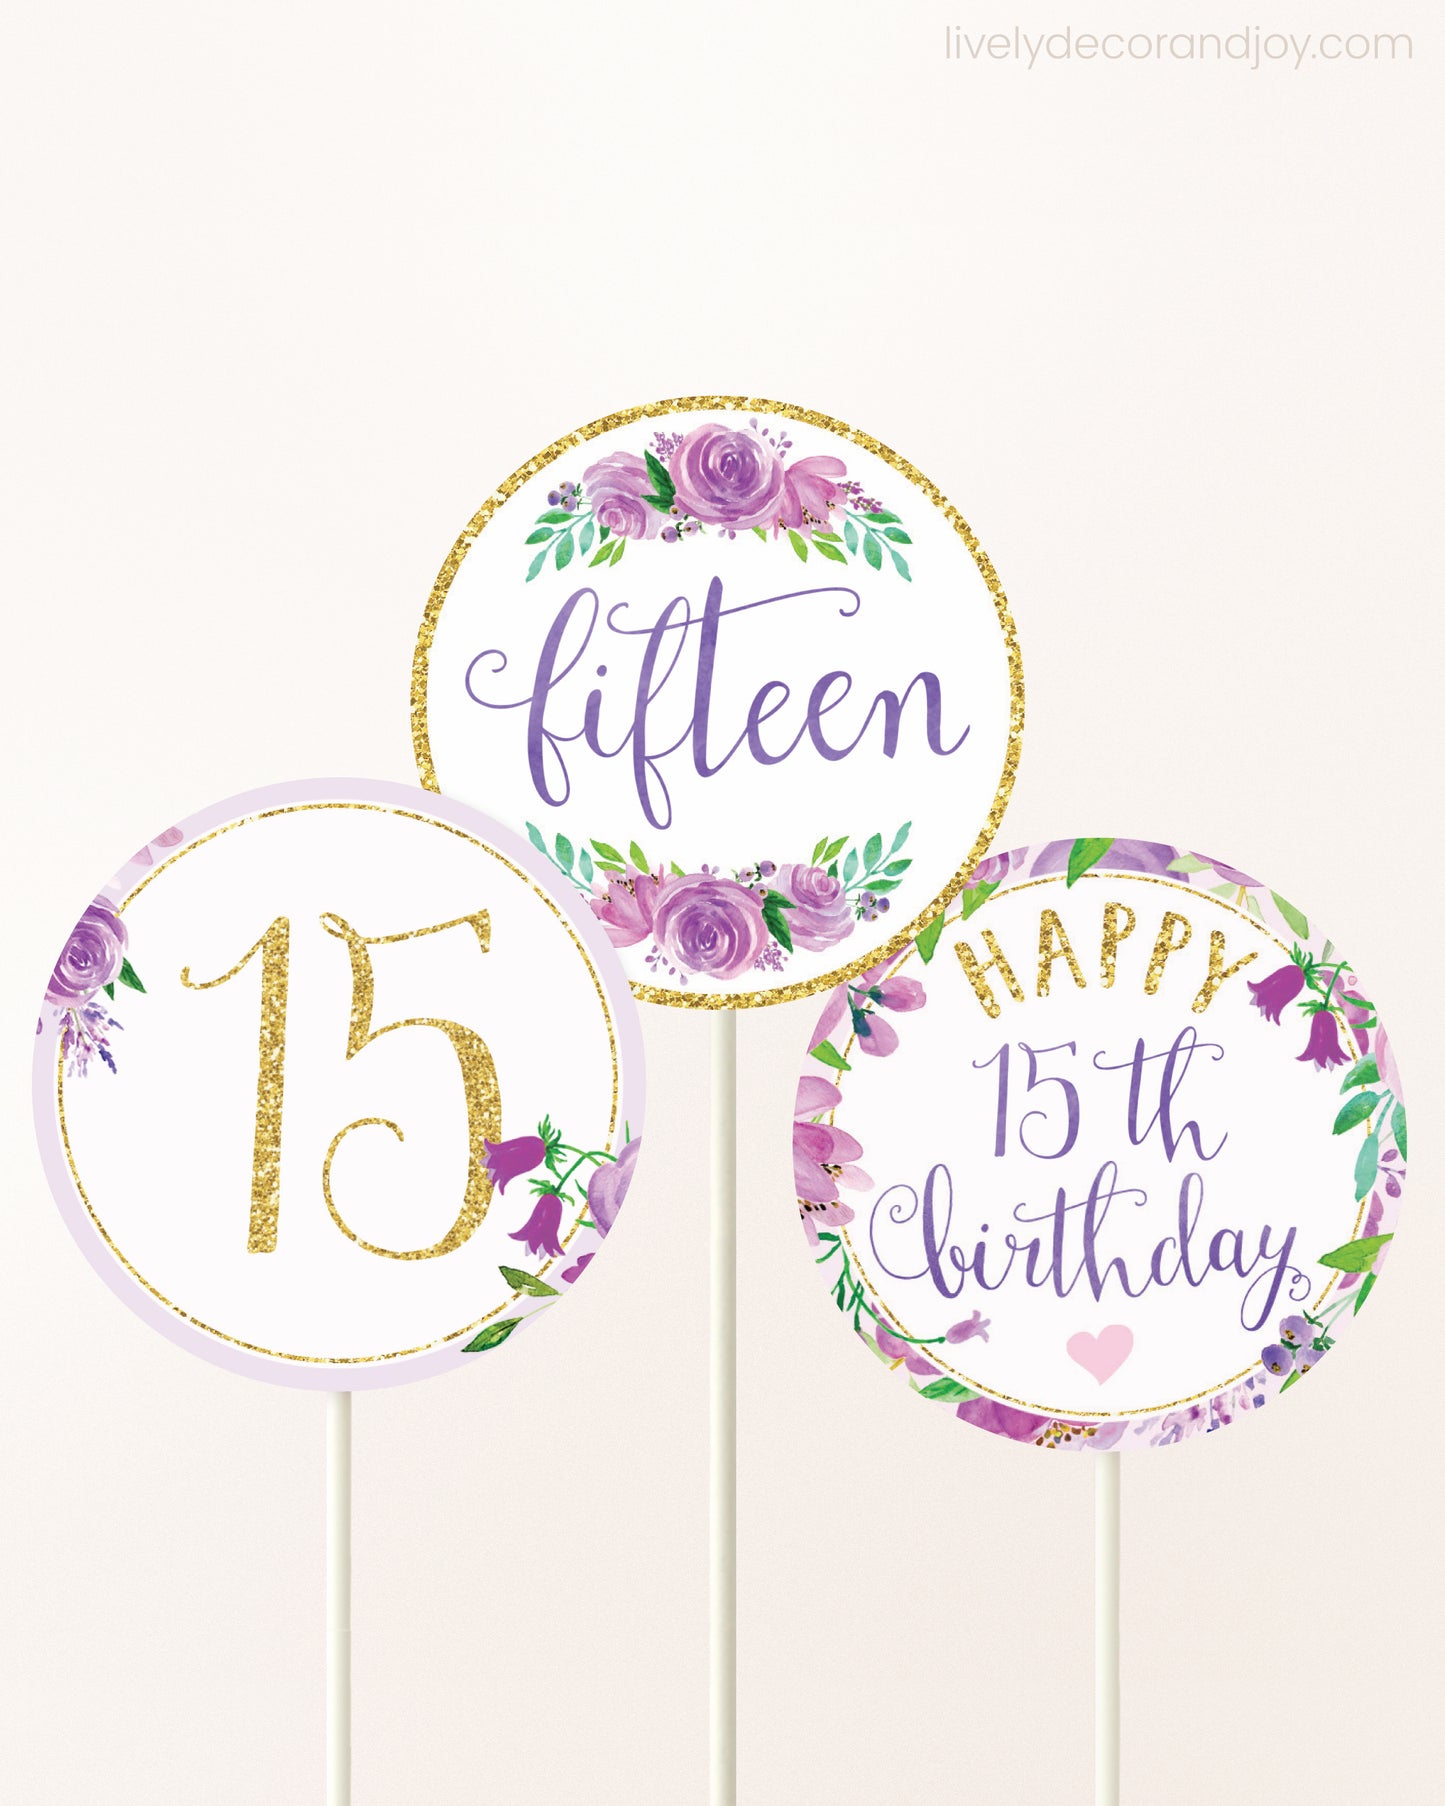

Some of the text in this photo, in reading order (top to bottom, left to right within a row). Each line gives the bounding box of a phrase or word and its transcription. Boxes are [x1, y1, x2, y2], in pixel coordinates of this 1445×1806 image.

[465, 576, 970, 829] fifteen
[953, 903, 1259, 1018] HAPPY
[180, 908, 503, 1260] 15
[870, 1161, 1311, 1331] birthday
